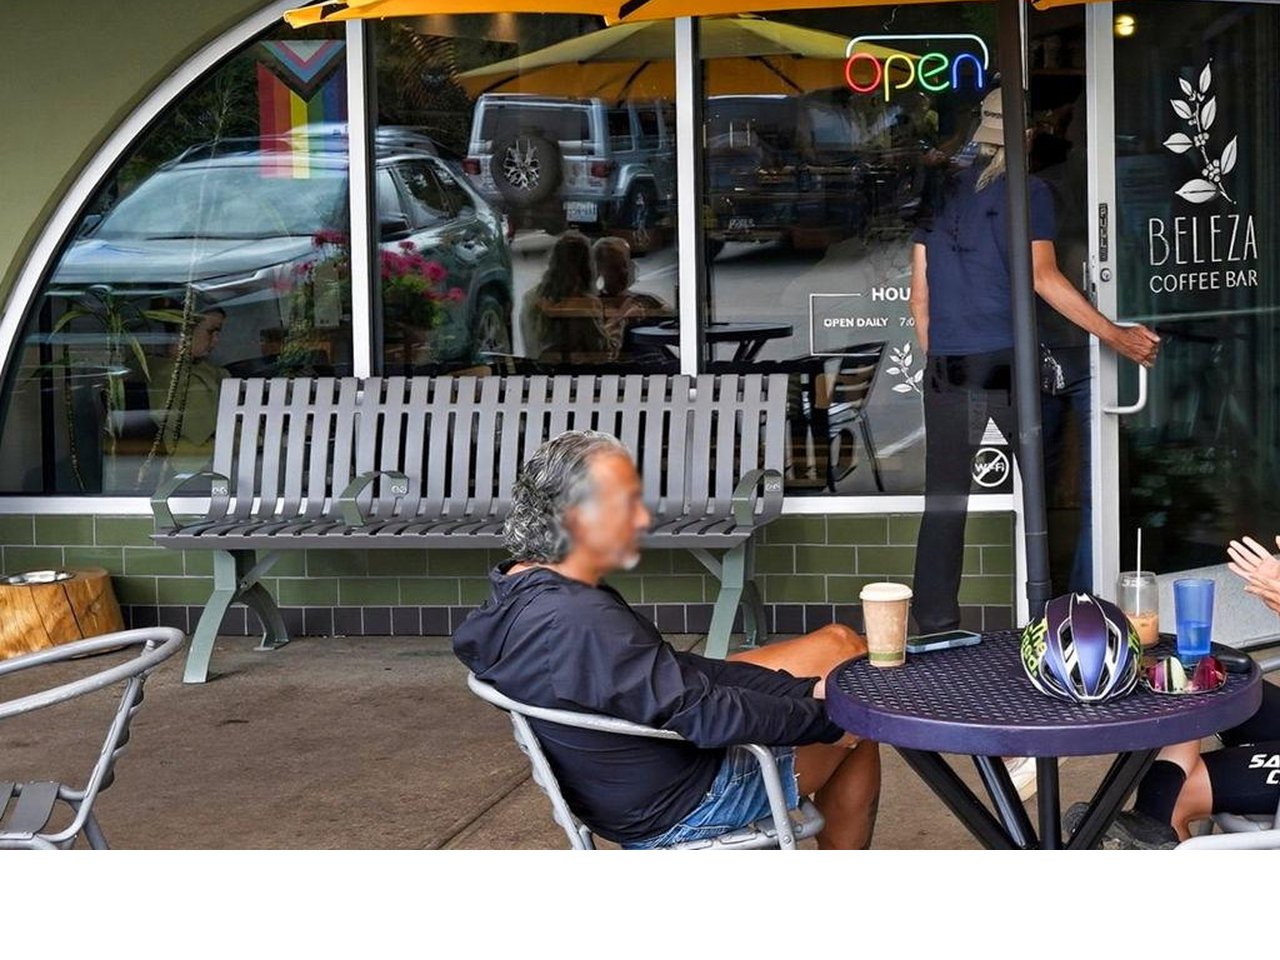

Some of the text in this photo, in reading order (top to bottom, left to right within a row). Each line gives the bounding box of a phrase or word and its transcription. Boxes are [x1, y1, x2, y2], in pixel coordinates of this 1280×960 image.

[844, 52, 984, 102] open
[1149, 214, 1259, 266] BELEZA
[1149, 269, 1259, 293] COFFEE BAR
[823, 318, 855, 328] OPEN
[856, 317, 889, 328] DAILY
